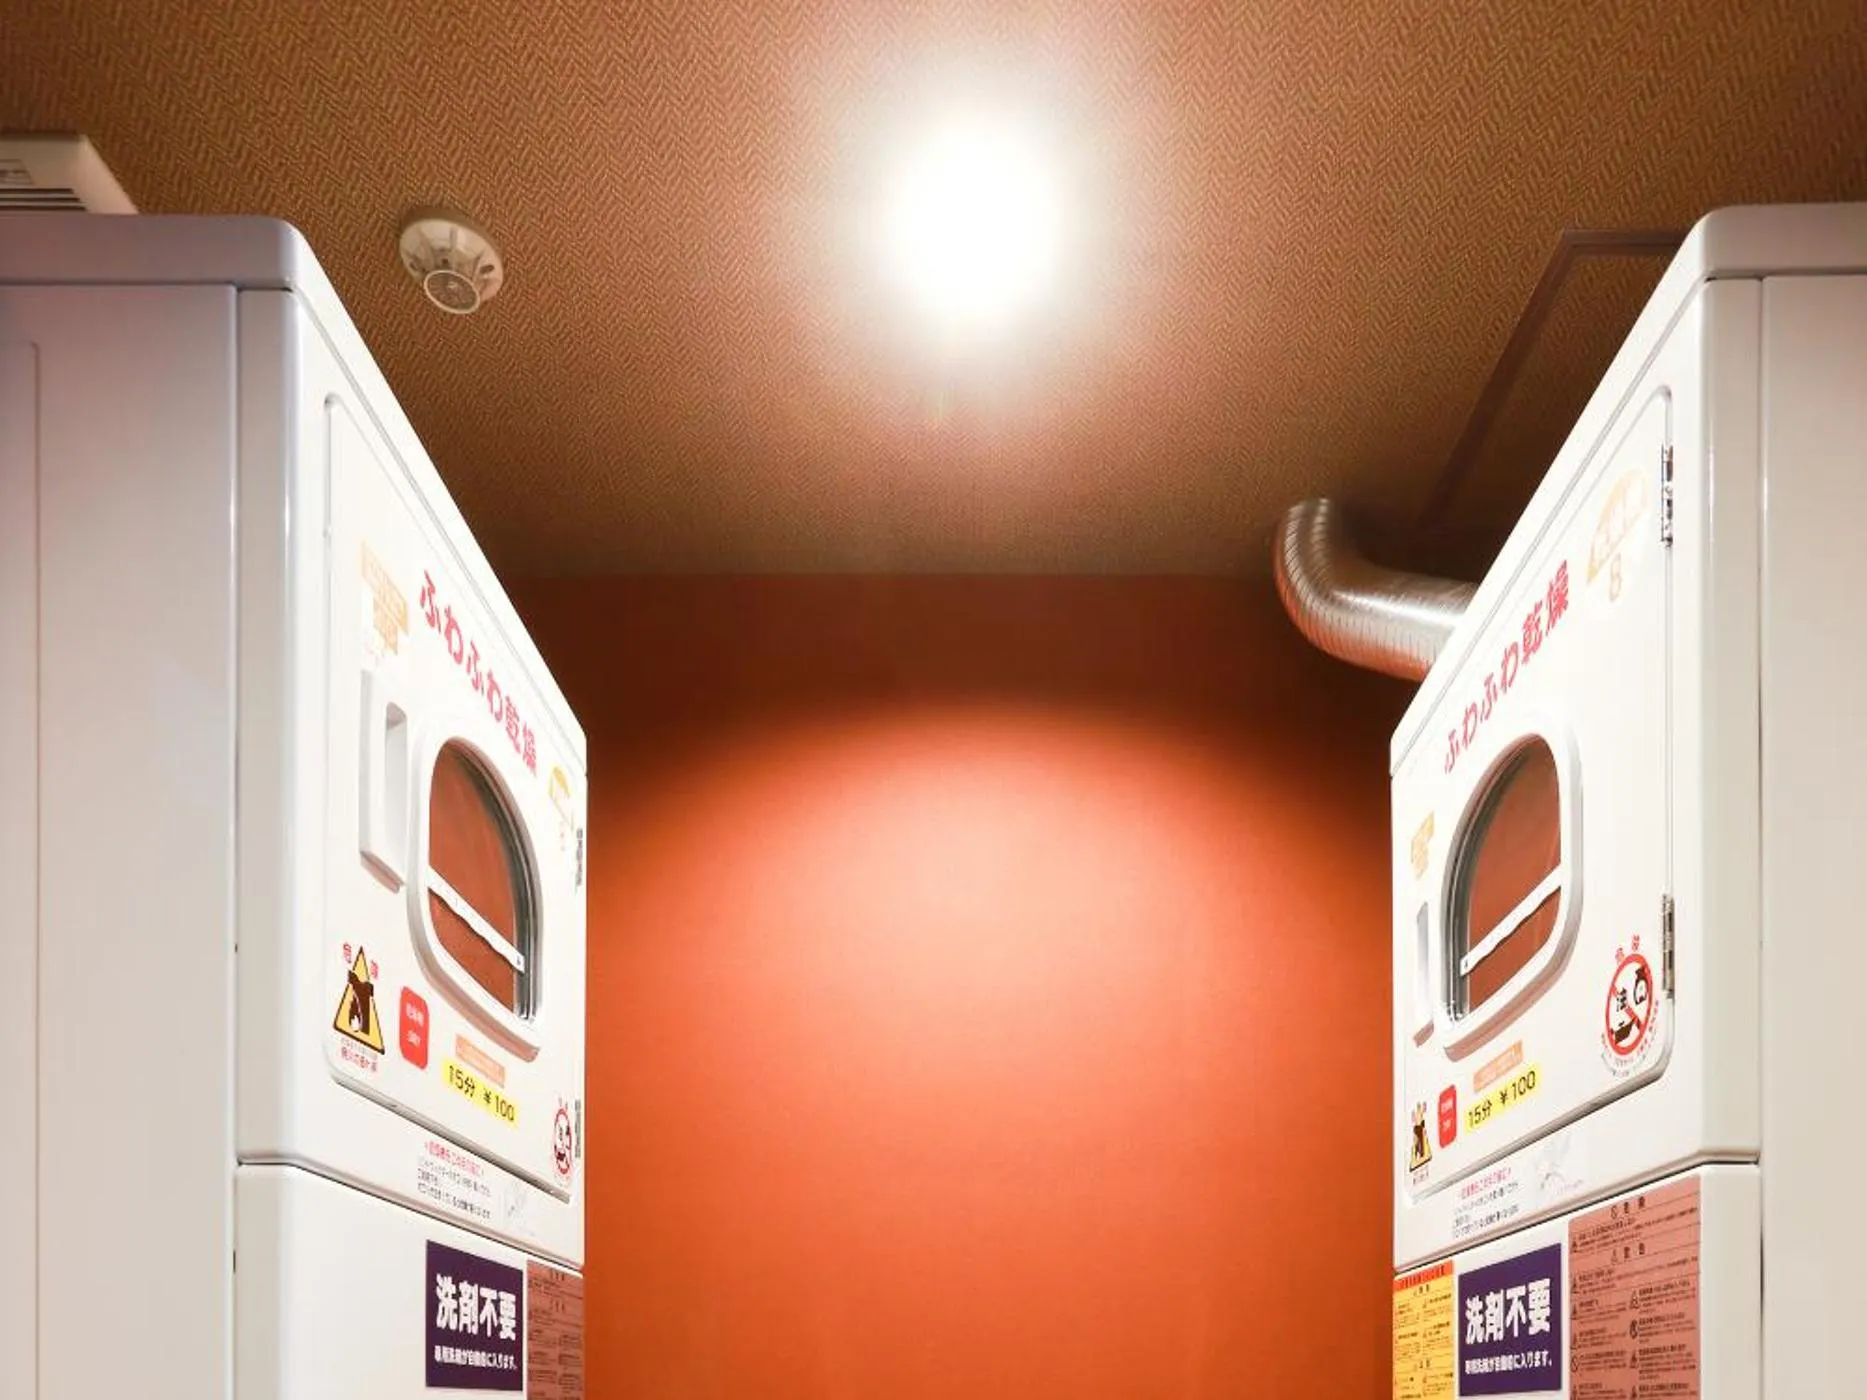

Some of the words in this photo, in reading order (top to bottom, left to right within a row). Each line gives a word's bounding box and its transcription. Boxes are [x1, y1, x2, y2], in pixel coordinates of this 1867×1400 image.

[1445, 560, 1568, 774] ふわふわ乾燥
[449, 1065, 475, 1098] 15分
[483, 1088, 515, 1121] ¥100
[1468, 1099, 1492, 1128] 15分
[1500, 1070, 1535, 1104] ¥100
[436, 1273, 516, 1340] 洗剤不要
[1465, 1278, 1551, 1344] 洗剤不要
